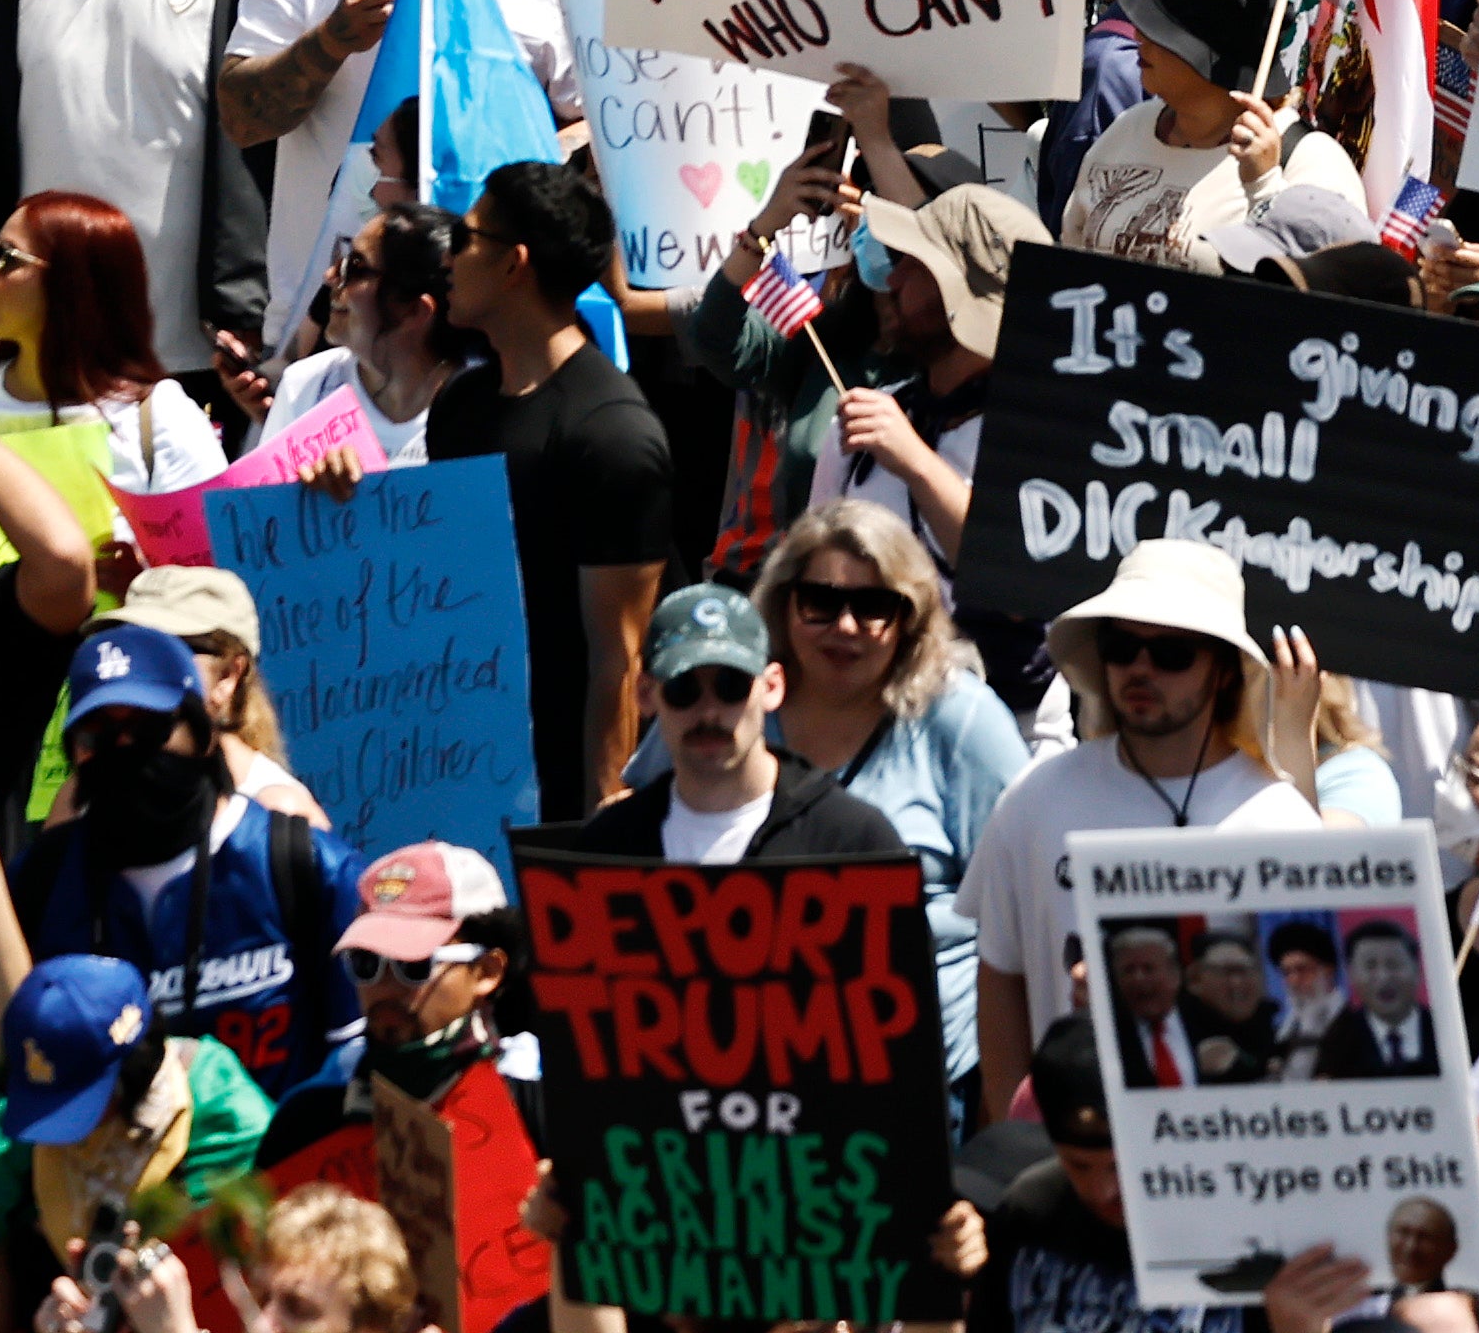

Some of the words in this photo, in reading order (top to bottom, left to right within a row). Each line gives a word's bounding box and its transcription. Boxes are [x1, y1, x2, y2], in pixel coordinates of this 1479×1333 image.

[1093, 862, 1245, 898] Military
[1258, 857, 1415, 888] Parades
[522, 867, 920, 979] DEPORT
[531, 973, 918, 1086] TRUMP
[1154, 1110, 1328, 1139] Assholes
[1340, 1103, 1434, 1134] Love
[1142, 1165, 1215, 1197] this
[1231, 1162, 1320, 1202] Type
[1333, 1160, 1371, 1190] of
[1384, 1155, 1463, 1187] Shit
